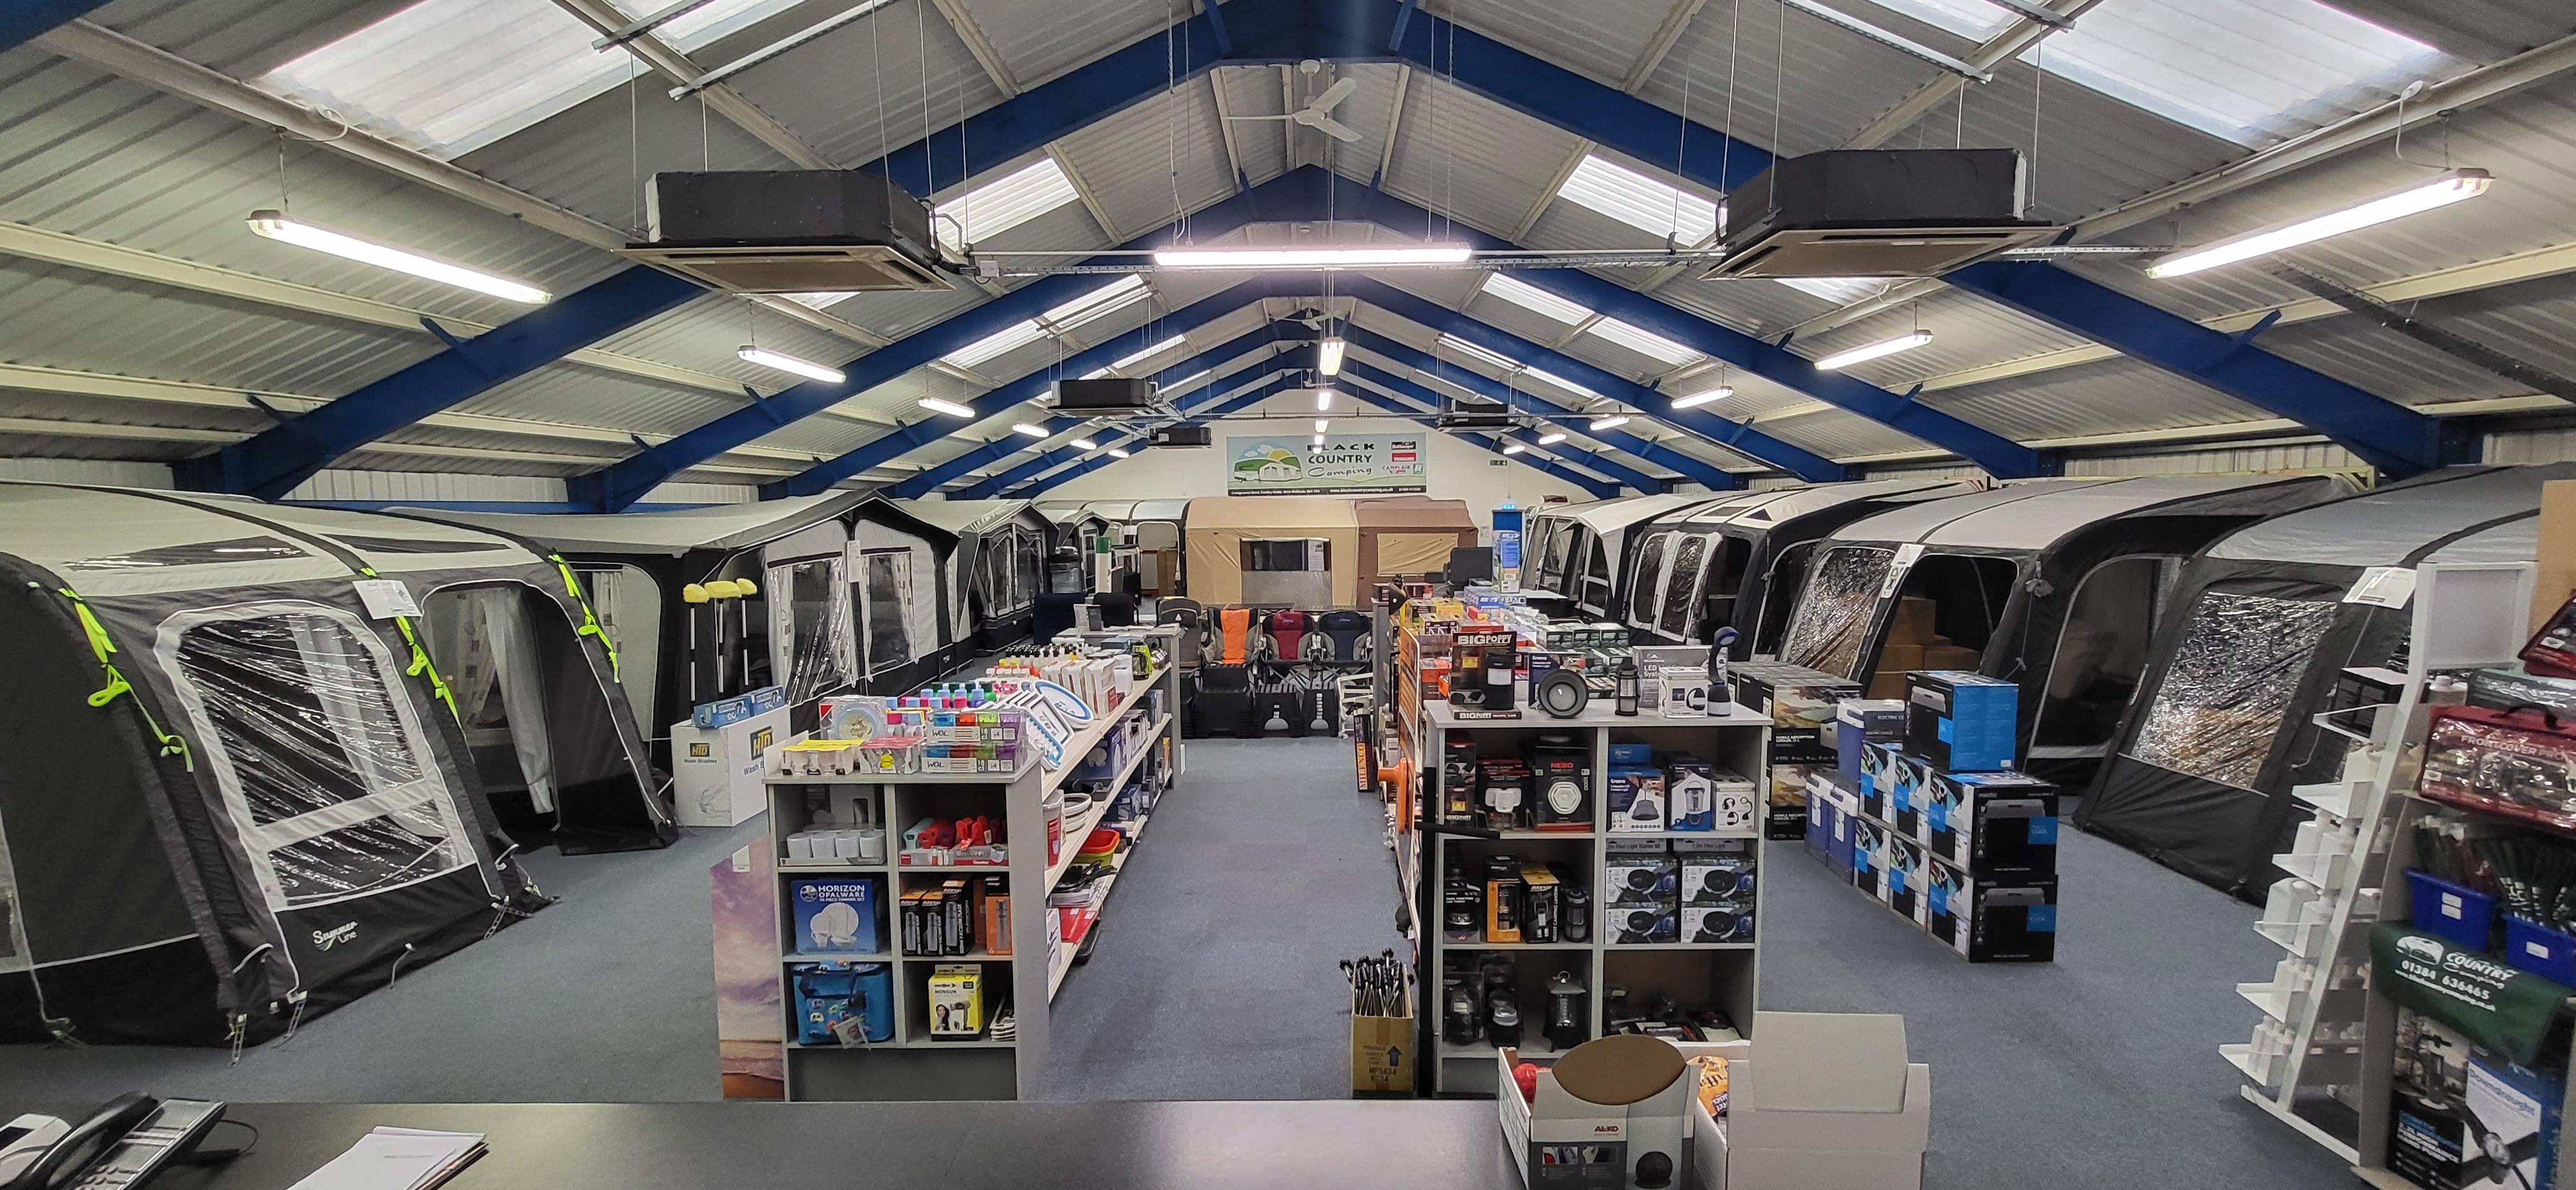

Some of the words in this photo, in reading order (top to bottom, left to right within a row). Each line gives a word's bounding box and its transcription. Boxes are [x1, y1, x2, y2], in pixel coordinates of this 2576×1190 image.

[1308, 454, 1372, 464] COUNTRY
[1308, 466, 1372, 477] Camping
[692, 744, 710, 756] HTD
[743, 762, 759, 775] Wash
[312, 921, 358, 944] Summer
[337, 931, 357, 943] Line
[2401, 959, 2436, 980] 01384
[2446, 952, 2514, 981] COUNTRY
[2441, 975, 2490, 1000] 636465
[2469, 1068, 2535, 1117] Downdraught
